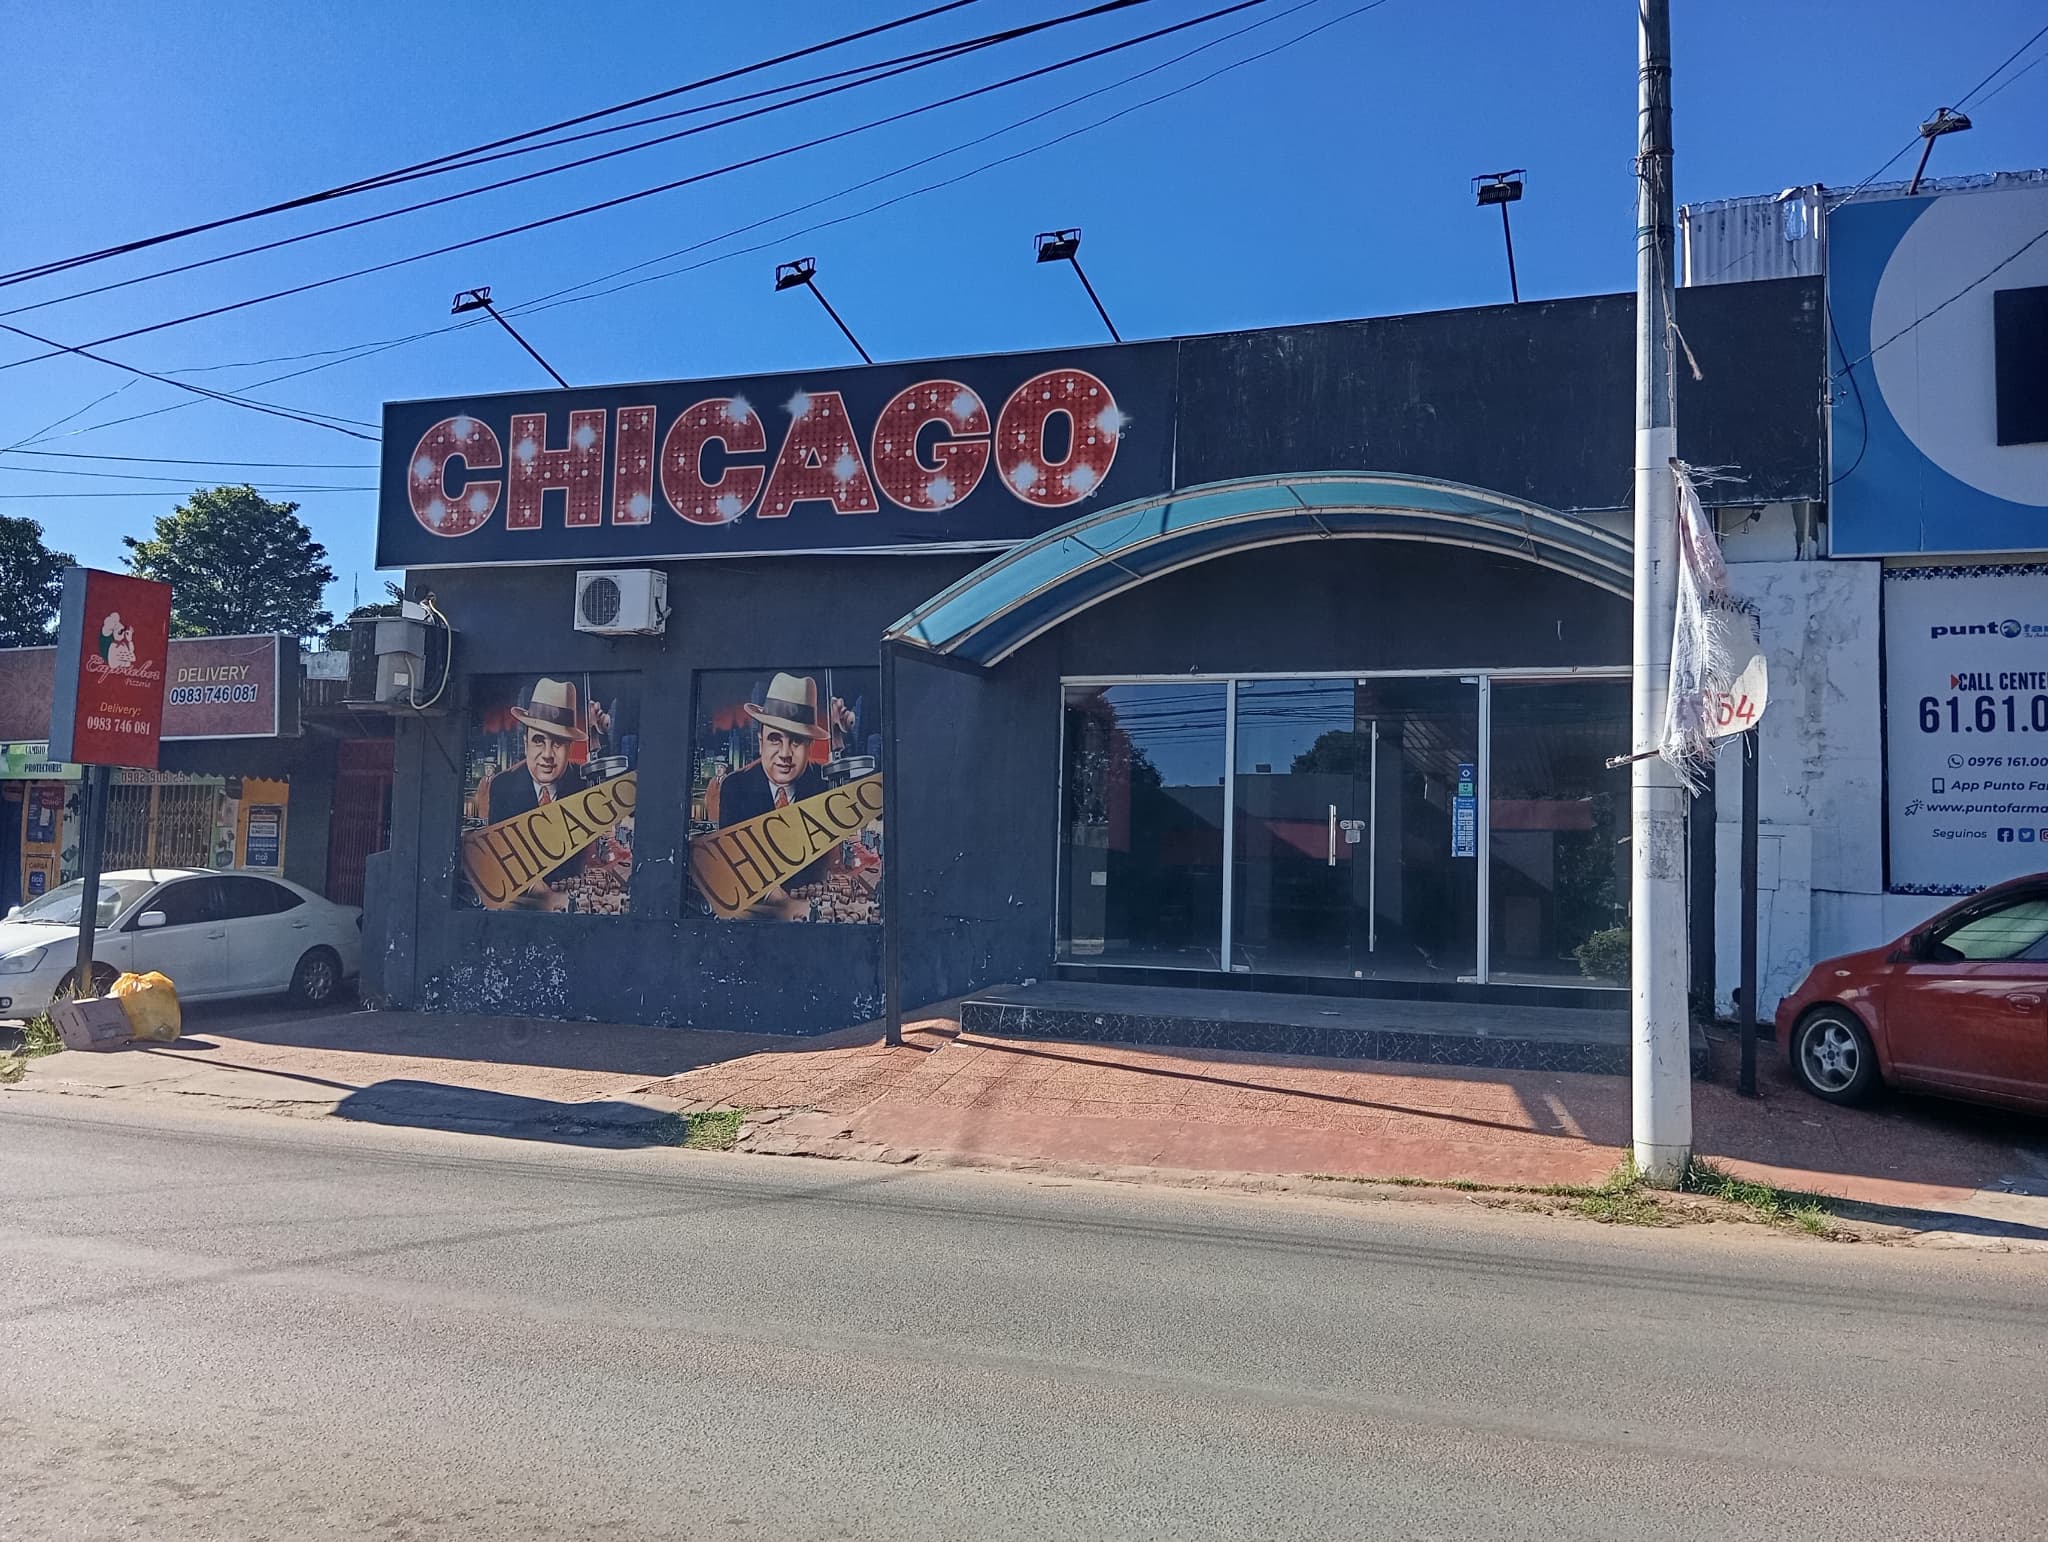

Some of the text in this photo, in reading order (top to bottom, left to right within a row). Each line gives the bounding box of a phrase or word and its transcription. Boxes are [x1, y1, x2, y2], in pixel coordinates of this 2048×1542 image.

[408, 368, 1120, 537] CHICAGO
[177, 665, 249, 682] DELIVERY
[1958, 672, 2048, 691] CALL CENTE
[170, 684, 258, 705] 0983 746 081
[100, 702, 141, 717] Delivery:
[87, 716, 151, 735] 0983 746 081
[24, 763, 62, 773] PROTECTORES
[1967, 757, 2003, 767] 0976
[1951, 781, 1979, 792] App
[1984, 781, 2025, 791] Punto
[463, 779, 637, 903] CHICAGO
[1932, 828, 1987, 839] Seguinos
[690, 781, 883, 911] CHICAGO
